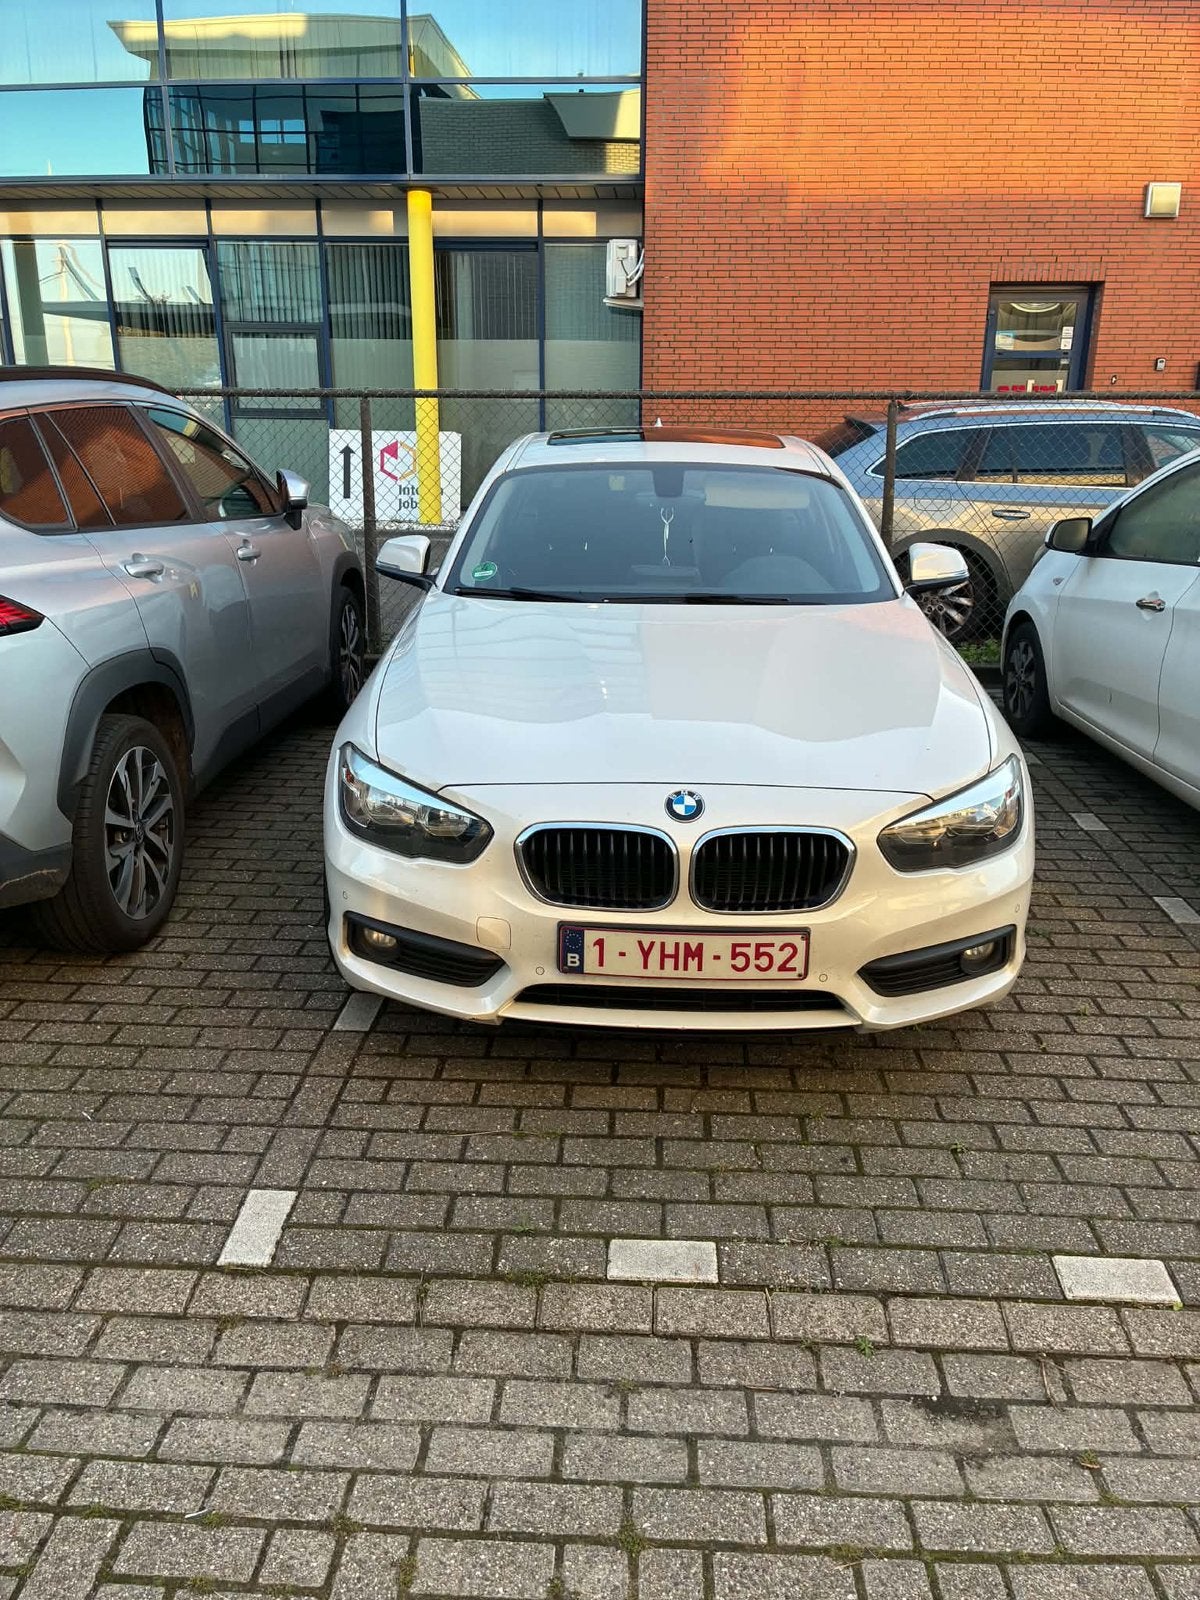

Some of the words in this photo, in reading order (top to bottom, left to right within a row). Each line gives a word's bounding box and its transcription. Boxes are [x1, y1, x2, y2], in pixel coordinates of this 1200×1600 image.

[668, 789, 702, 801] BMW
[566, 953, 580, 967] B
[592, 937, 799, 973] 1-YHM-552
